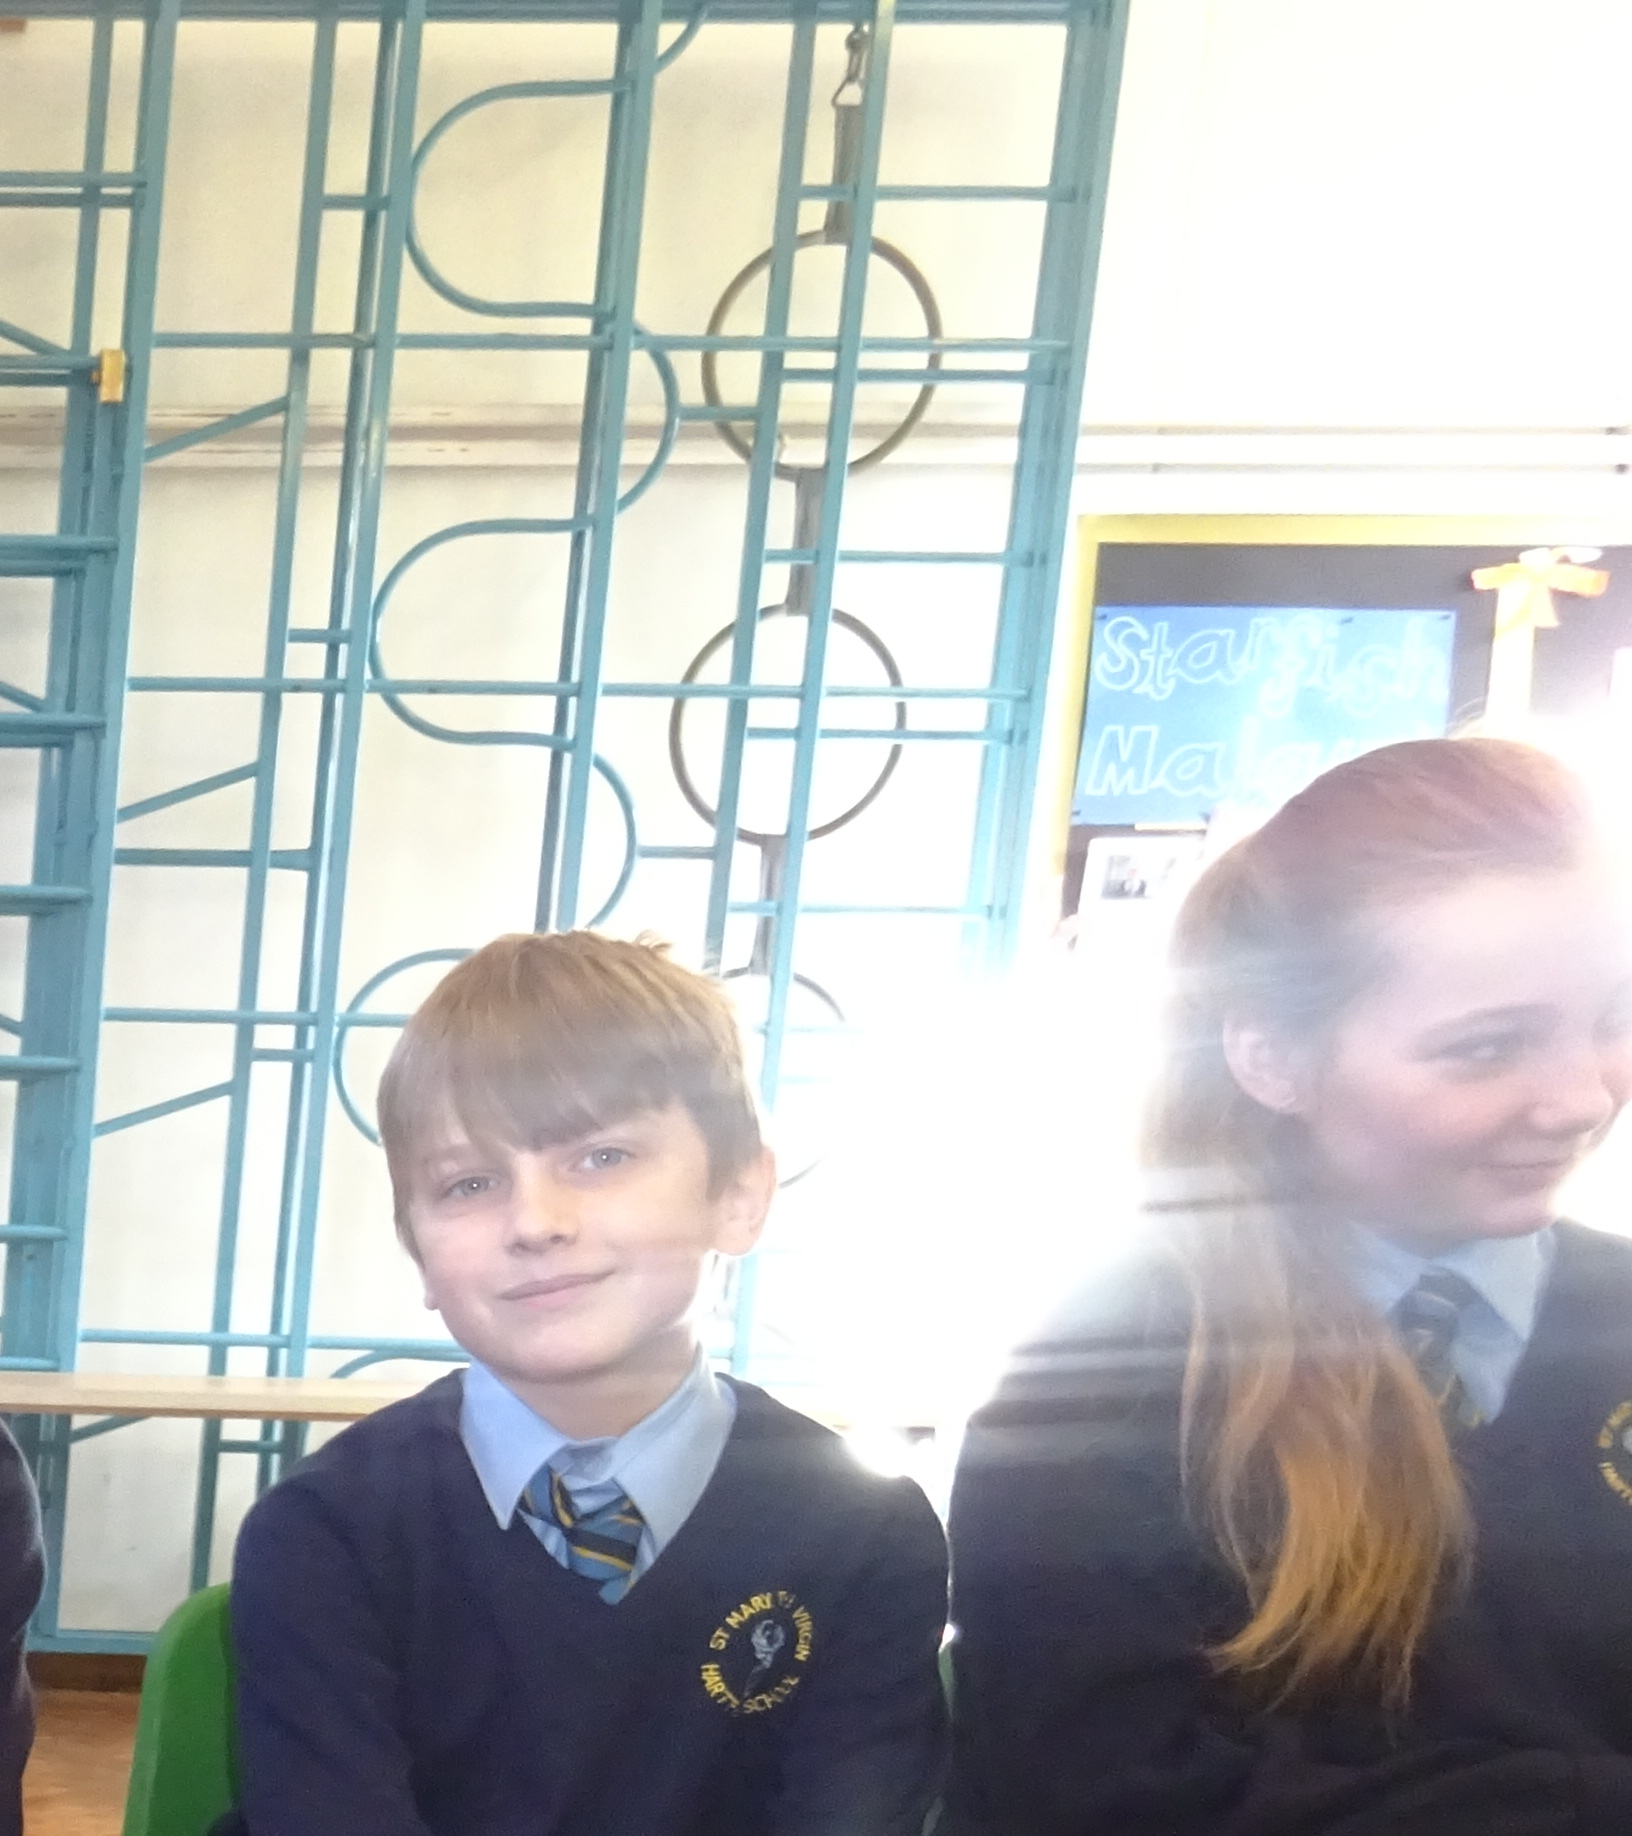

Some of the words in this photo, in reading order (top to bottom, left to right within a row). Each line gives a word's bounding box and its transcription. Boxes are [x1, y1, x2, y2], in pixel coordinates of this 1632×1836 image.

[1094, 614, 1448, 719] Starfish
[709, 1627, 730, 1650] ST
[725, 1591, 773, 1629] MARY
